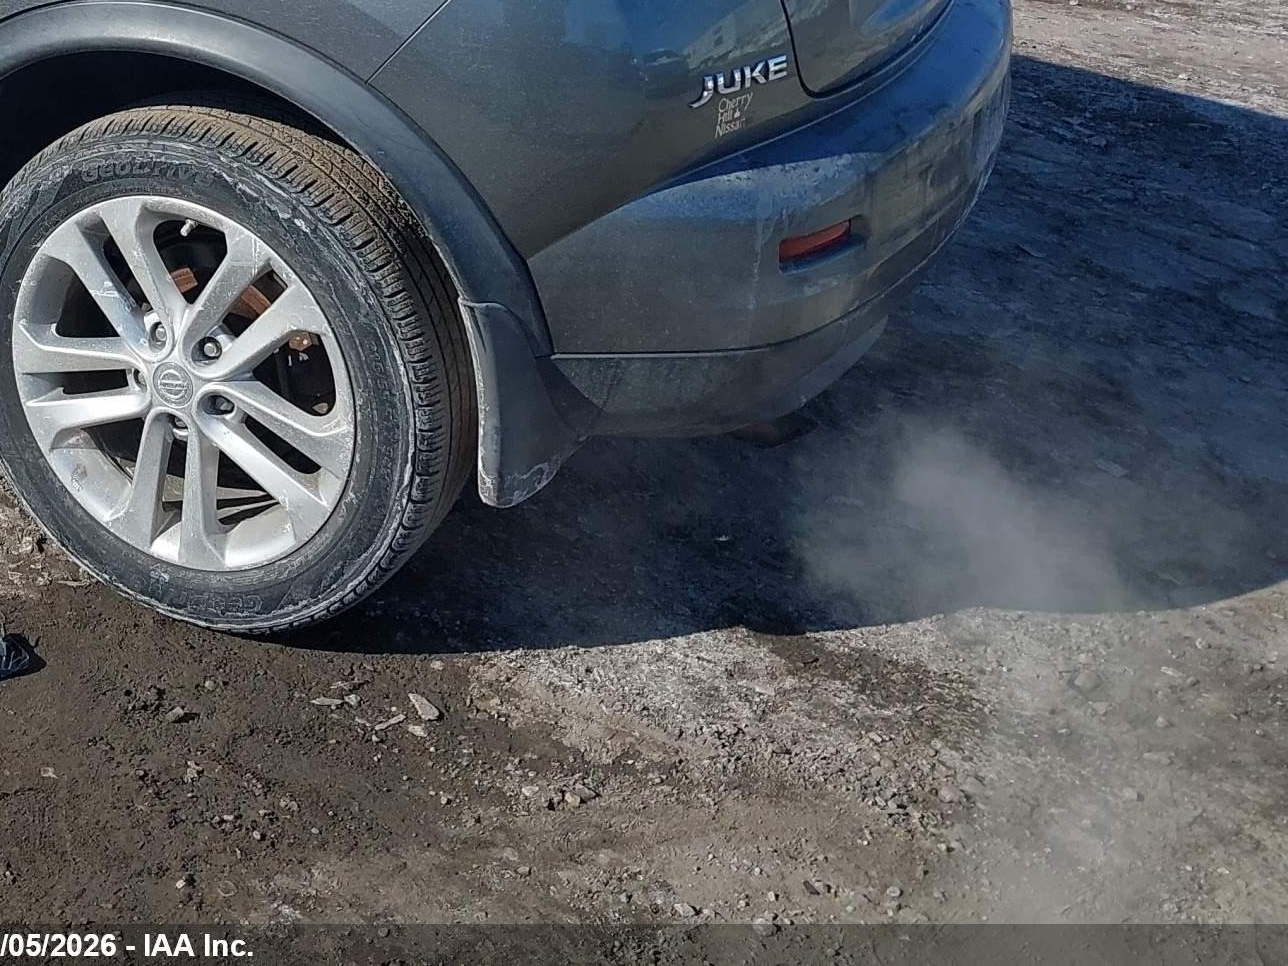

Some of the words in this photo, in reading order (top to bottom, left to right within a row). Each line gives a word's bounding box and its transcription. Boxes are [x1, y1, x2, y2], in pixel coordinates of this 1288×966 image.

[689, 55, 788, 109] JUKE
[718, 92, 753, 113] Cherry
[718, 109, 733, 125] Hill
[714, 117, 746, 139] Nissan
